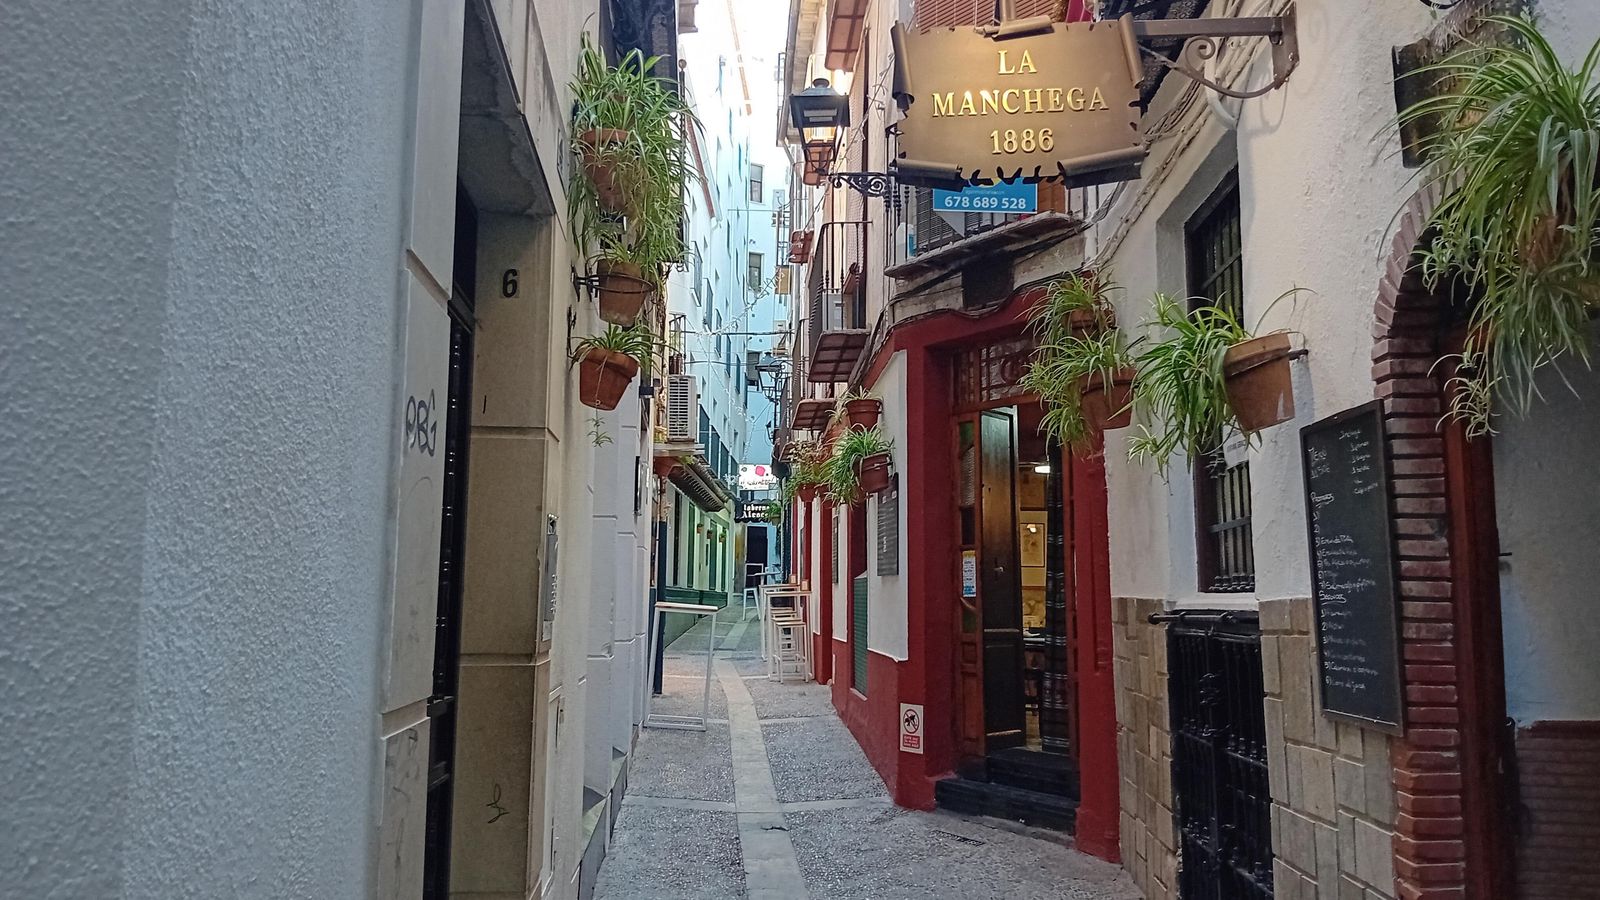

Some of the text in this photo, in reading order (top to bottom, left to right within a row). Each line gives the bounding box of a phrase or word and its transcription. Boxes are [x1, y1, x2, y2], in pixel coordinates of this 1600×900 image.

[997, 49, 1038, 75] LA
[932, 86, 1109, 118] MANCHEGA
[990, 128, 1055, 155] 1886
[944, 196, 1026, 209] 678 689 528
[502, 268, 519, 298] 6
